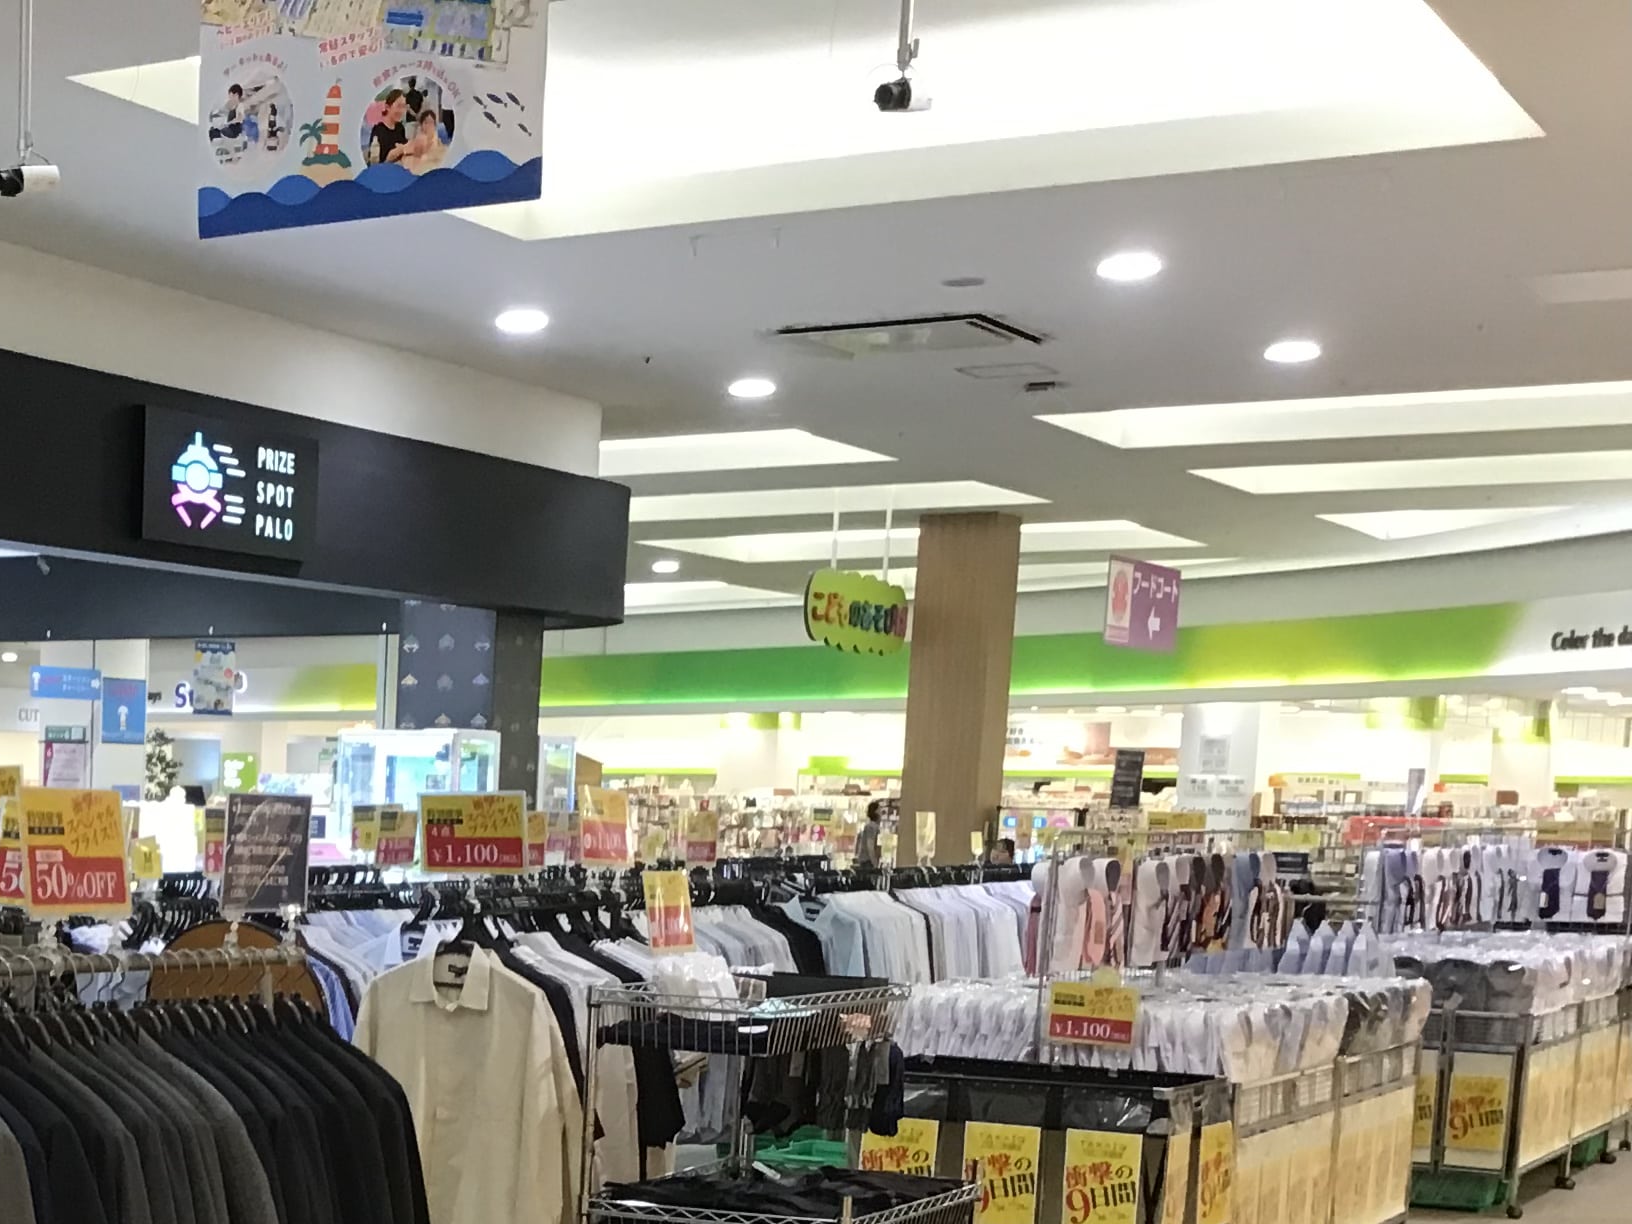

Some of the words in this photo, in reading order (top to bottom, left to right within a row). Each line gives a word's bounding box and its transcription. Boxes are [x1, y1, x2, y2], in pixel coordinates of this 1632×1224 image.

[257, 446, 295, 475] PRIZE
[256, 481, 294, 508] SPOT
[255, 514, 293, 541] PALO
[1133, 571, 1178, 604] フードコート
[18, 708, 40, 723] CUT
[432, 843, 499, 864] ¥1,100
[36, 863, 118, 900] 50%OFF
